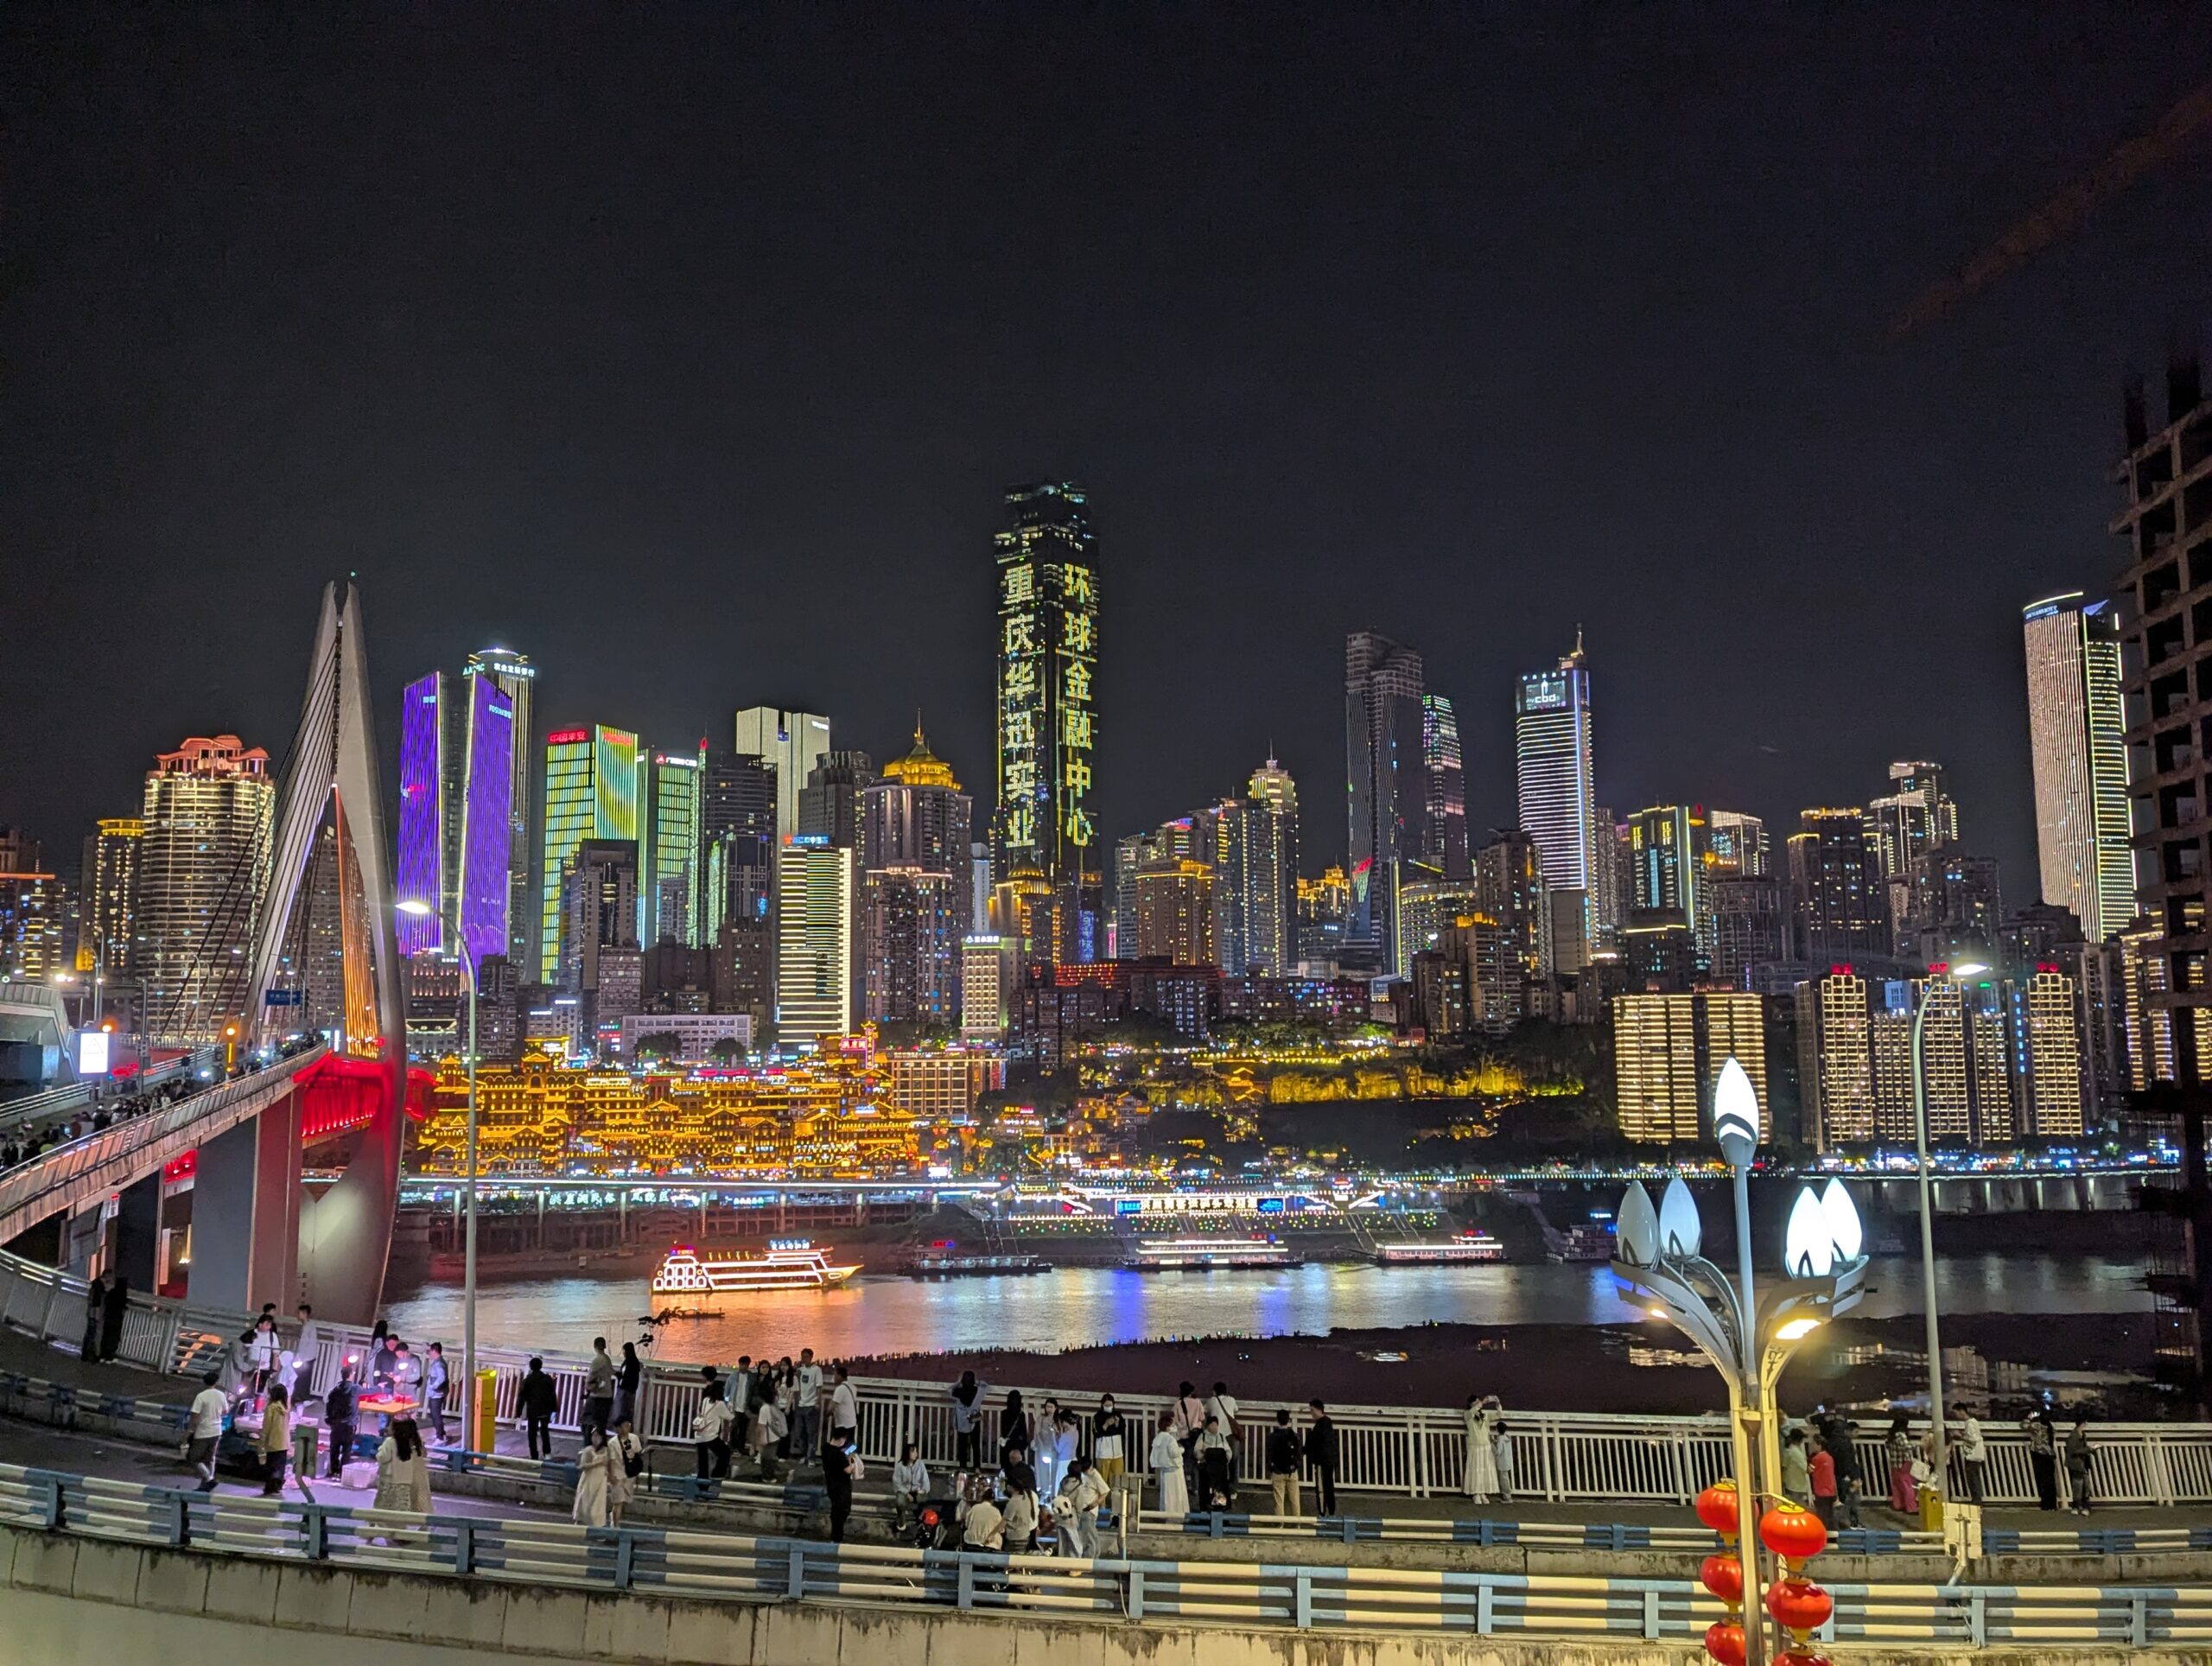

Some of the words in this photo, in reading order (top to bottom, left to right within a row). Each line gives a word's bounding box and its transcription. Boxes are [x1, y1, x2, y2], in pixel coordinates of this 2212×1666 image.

[549, 731, 587, 742] 中国平安
[1005, 563, 1035, 849] 重庆华迅实业
[1064, 563, 1092, 847] 环球金融中心
